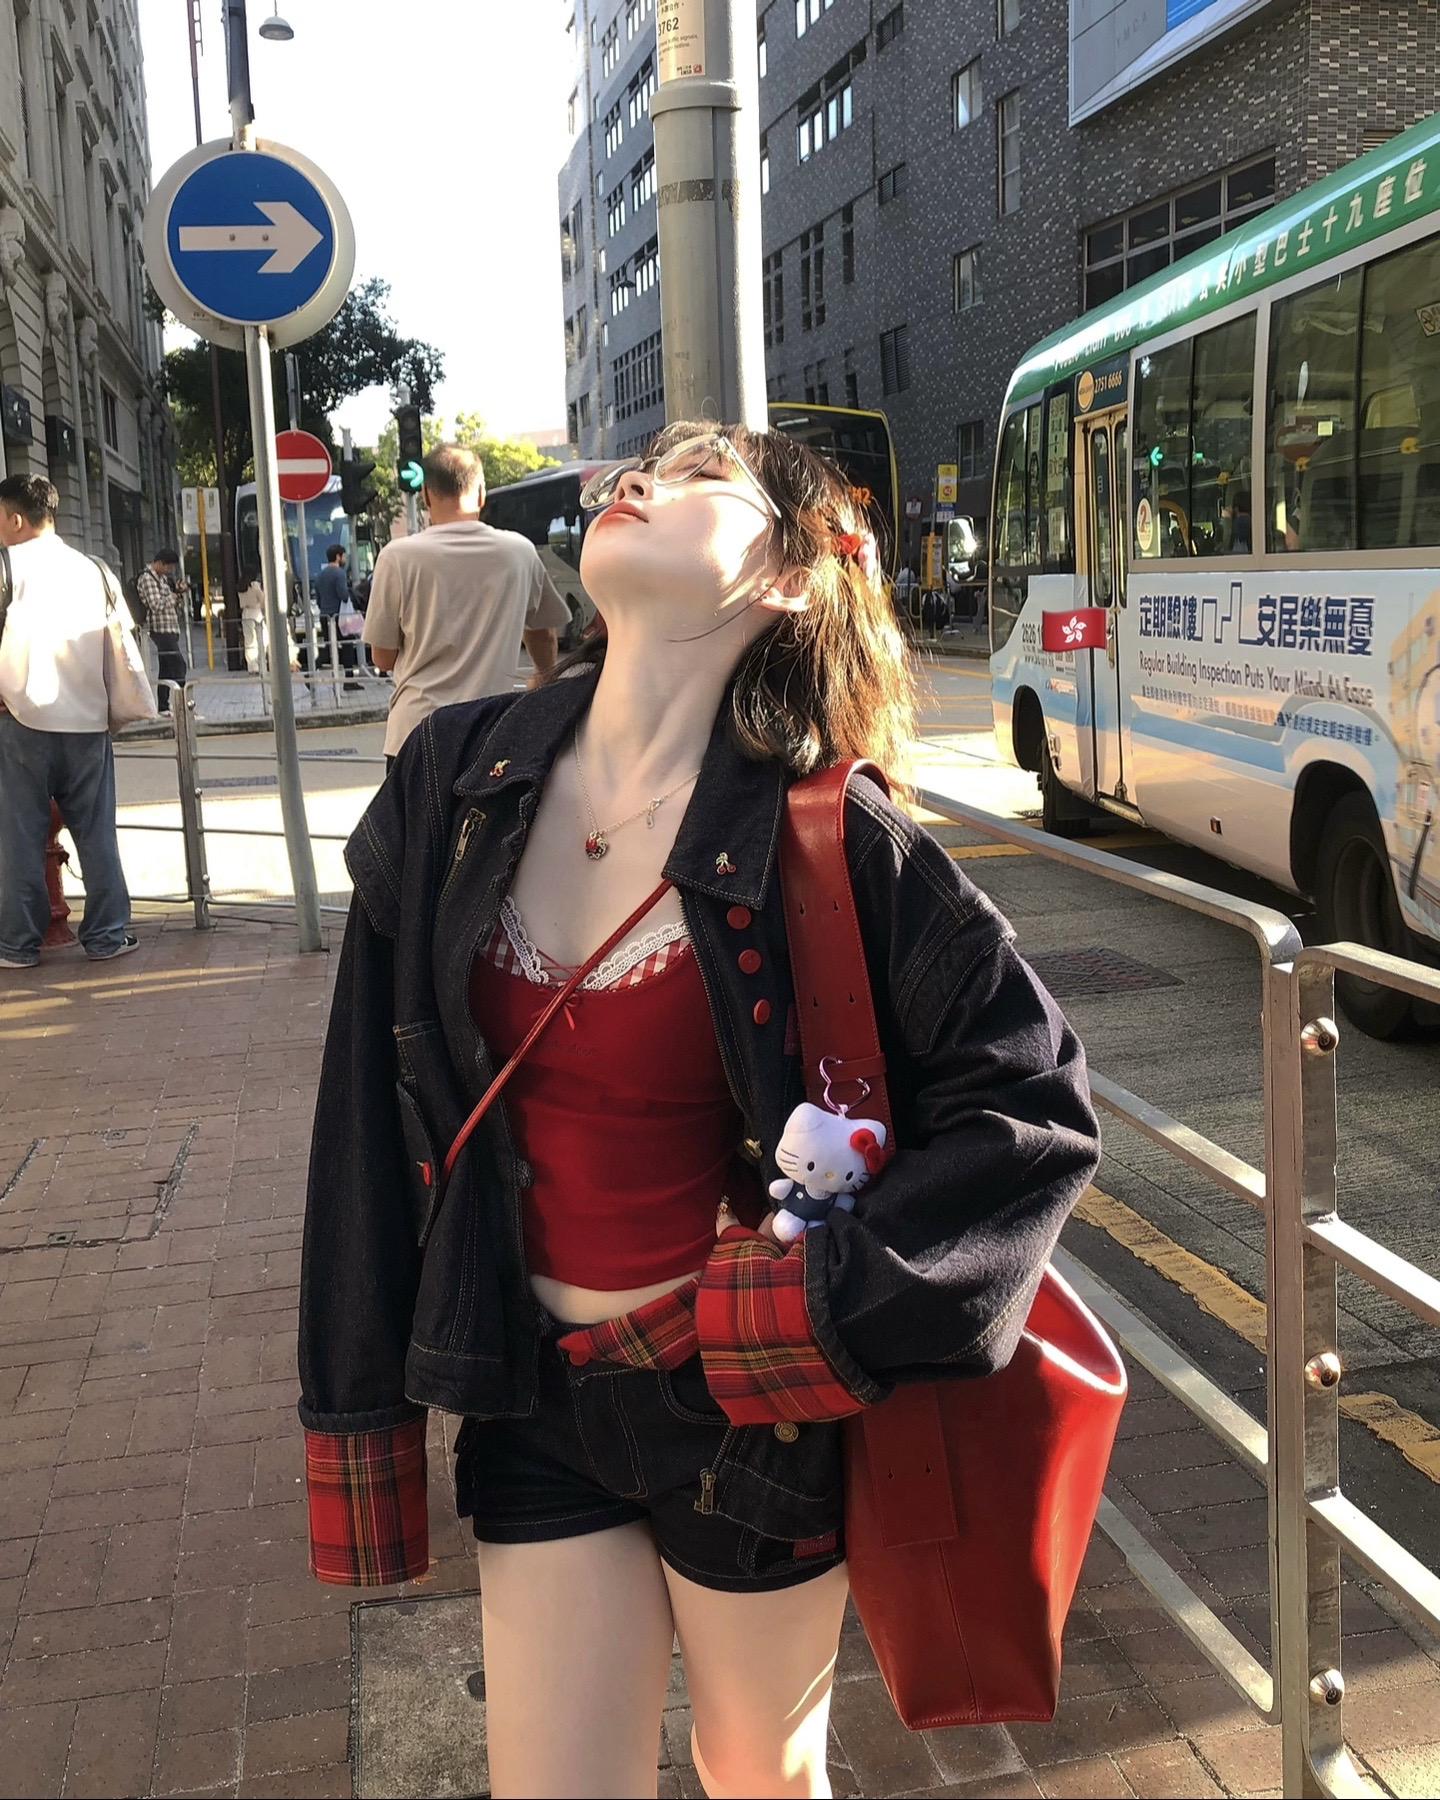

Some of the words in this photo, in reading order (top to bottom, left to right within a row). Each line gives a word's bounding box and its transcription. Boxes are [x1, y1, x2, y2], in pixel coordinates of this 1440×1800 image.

[1140, 504, 1147, 533] 2
[1258, 595, 1375, 656] 安居樂無憂
[1140, 650, 1164, 677] Regular
[1167, 652, 1197, 684] Building
[1199, 658, 1241, 687] Inspection
[1245, 664, 1264, 688] Puts
[1266, 666, 1290, 693] Your
[1295, 670, 1325, 698] Mind
[1328, 674, 1341, 701] At
[1344, 677, 1373, 707] Ease
